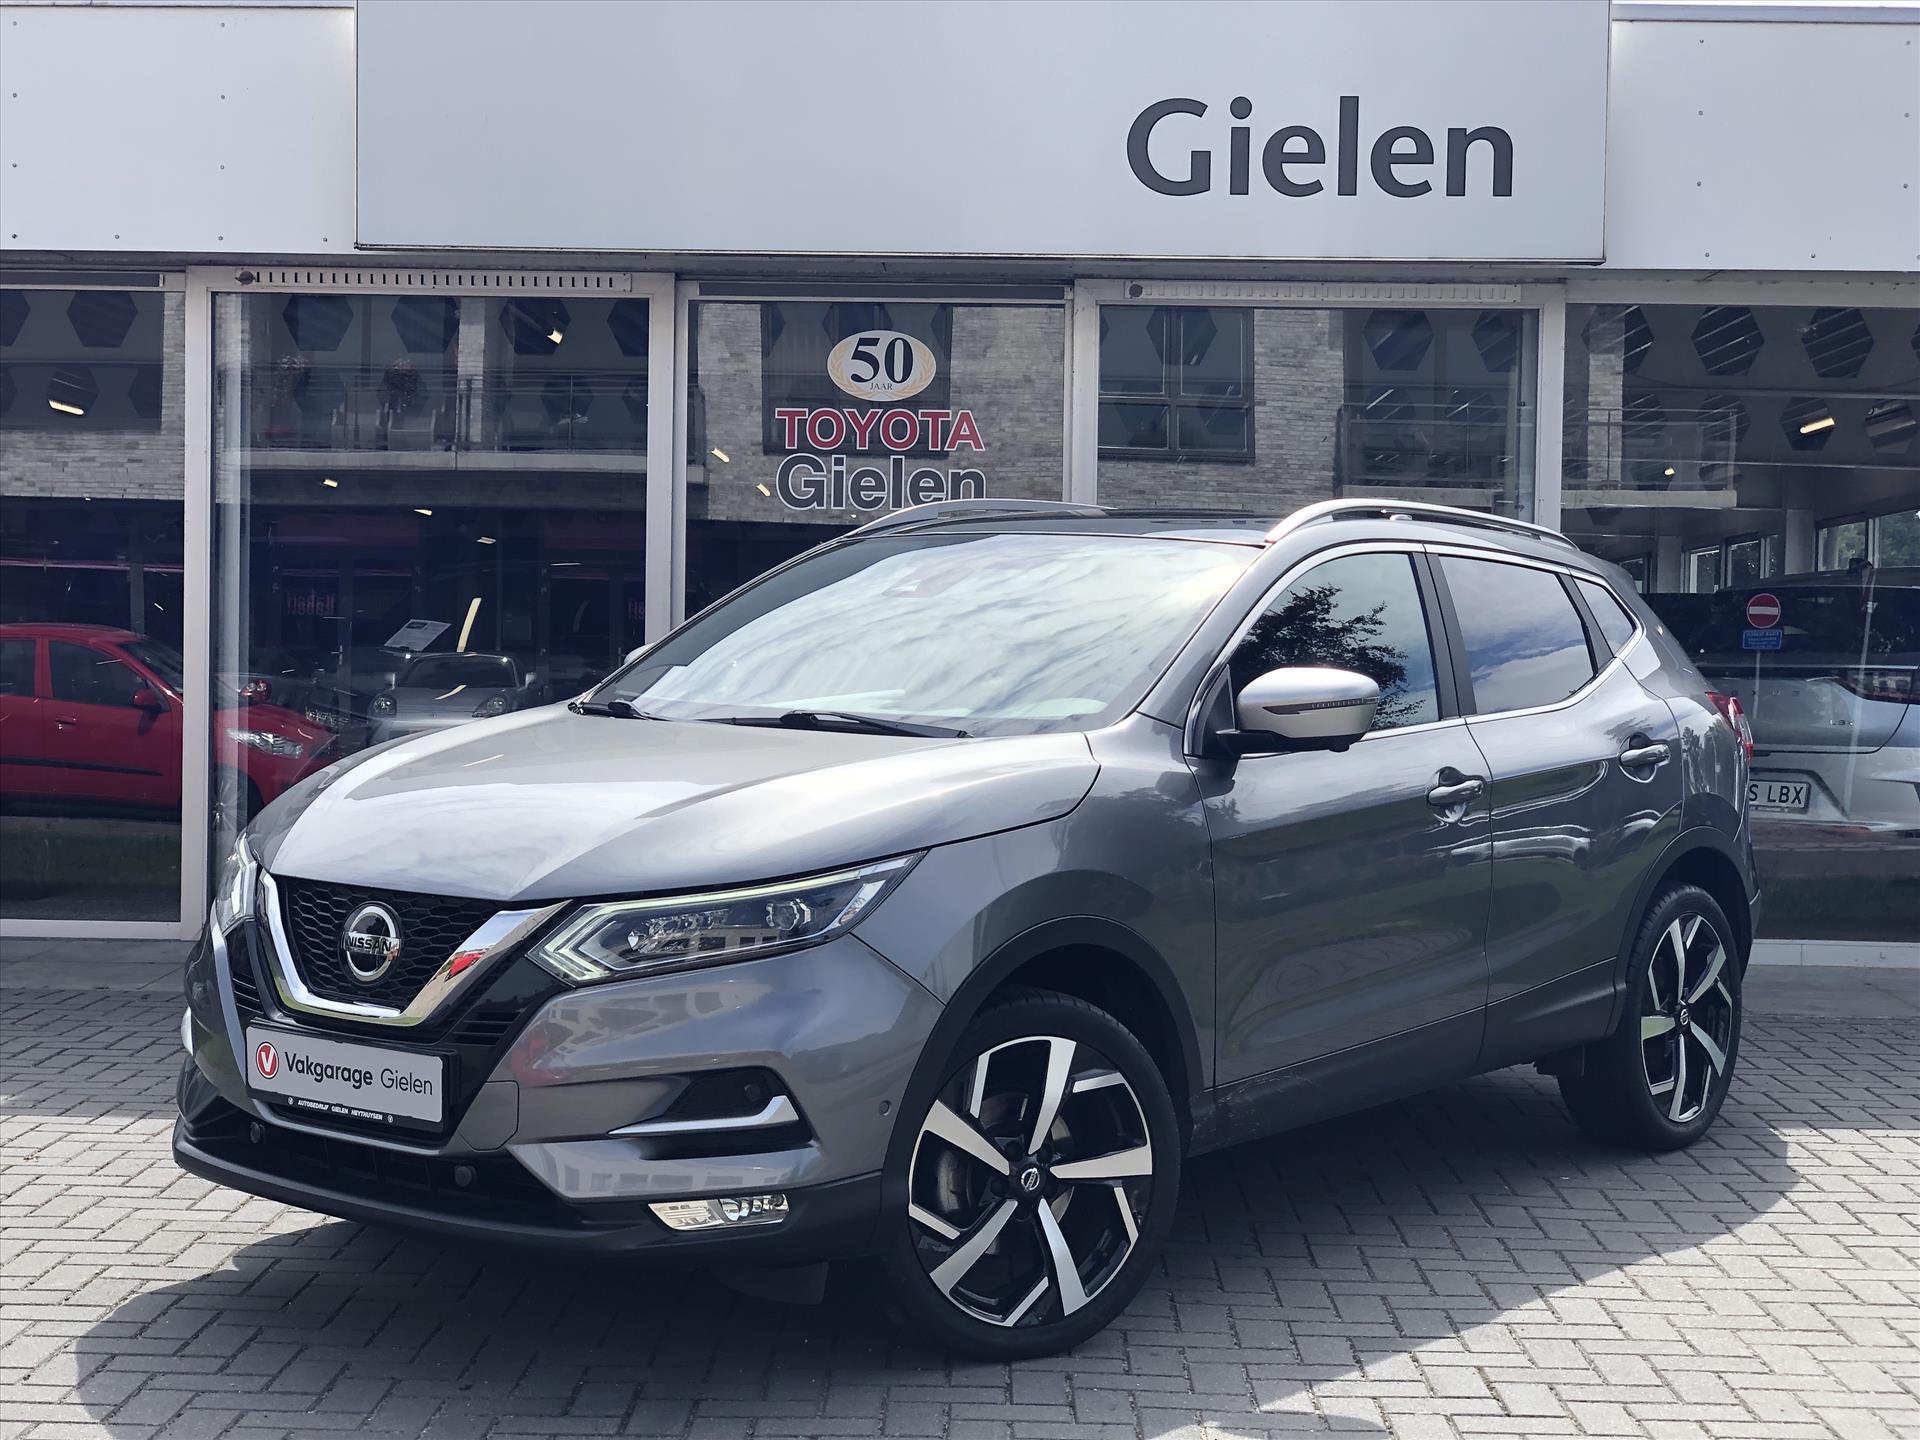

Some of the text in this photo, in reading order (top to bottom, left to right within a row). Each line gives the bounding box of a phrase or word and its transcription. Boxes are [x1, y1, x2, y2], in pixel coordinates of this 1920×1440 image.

[1126, 95, 1514, 198] Gielen
[850, 337, 914, 384] 50
[869, 382, 893, 391] JAAR
[775, 407, 985, 451] TOYOTA
[776, 453, 986, 511] Gielen
[1767, 784, 1804, 805] LBX
[347, 936, 392, 952] NISSAN
[284, 1051, 373, 1090] Vakgarage
[380, 1067, 433, 1096] Gielen
[297, 1099, 383, 1121] AUTOBEDRIJF GIELEN HEYTHUYSEN
